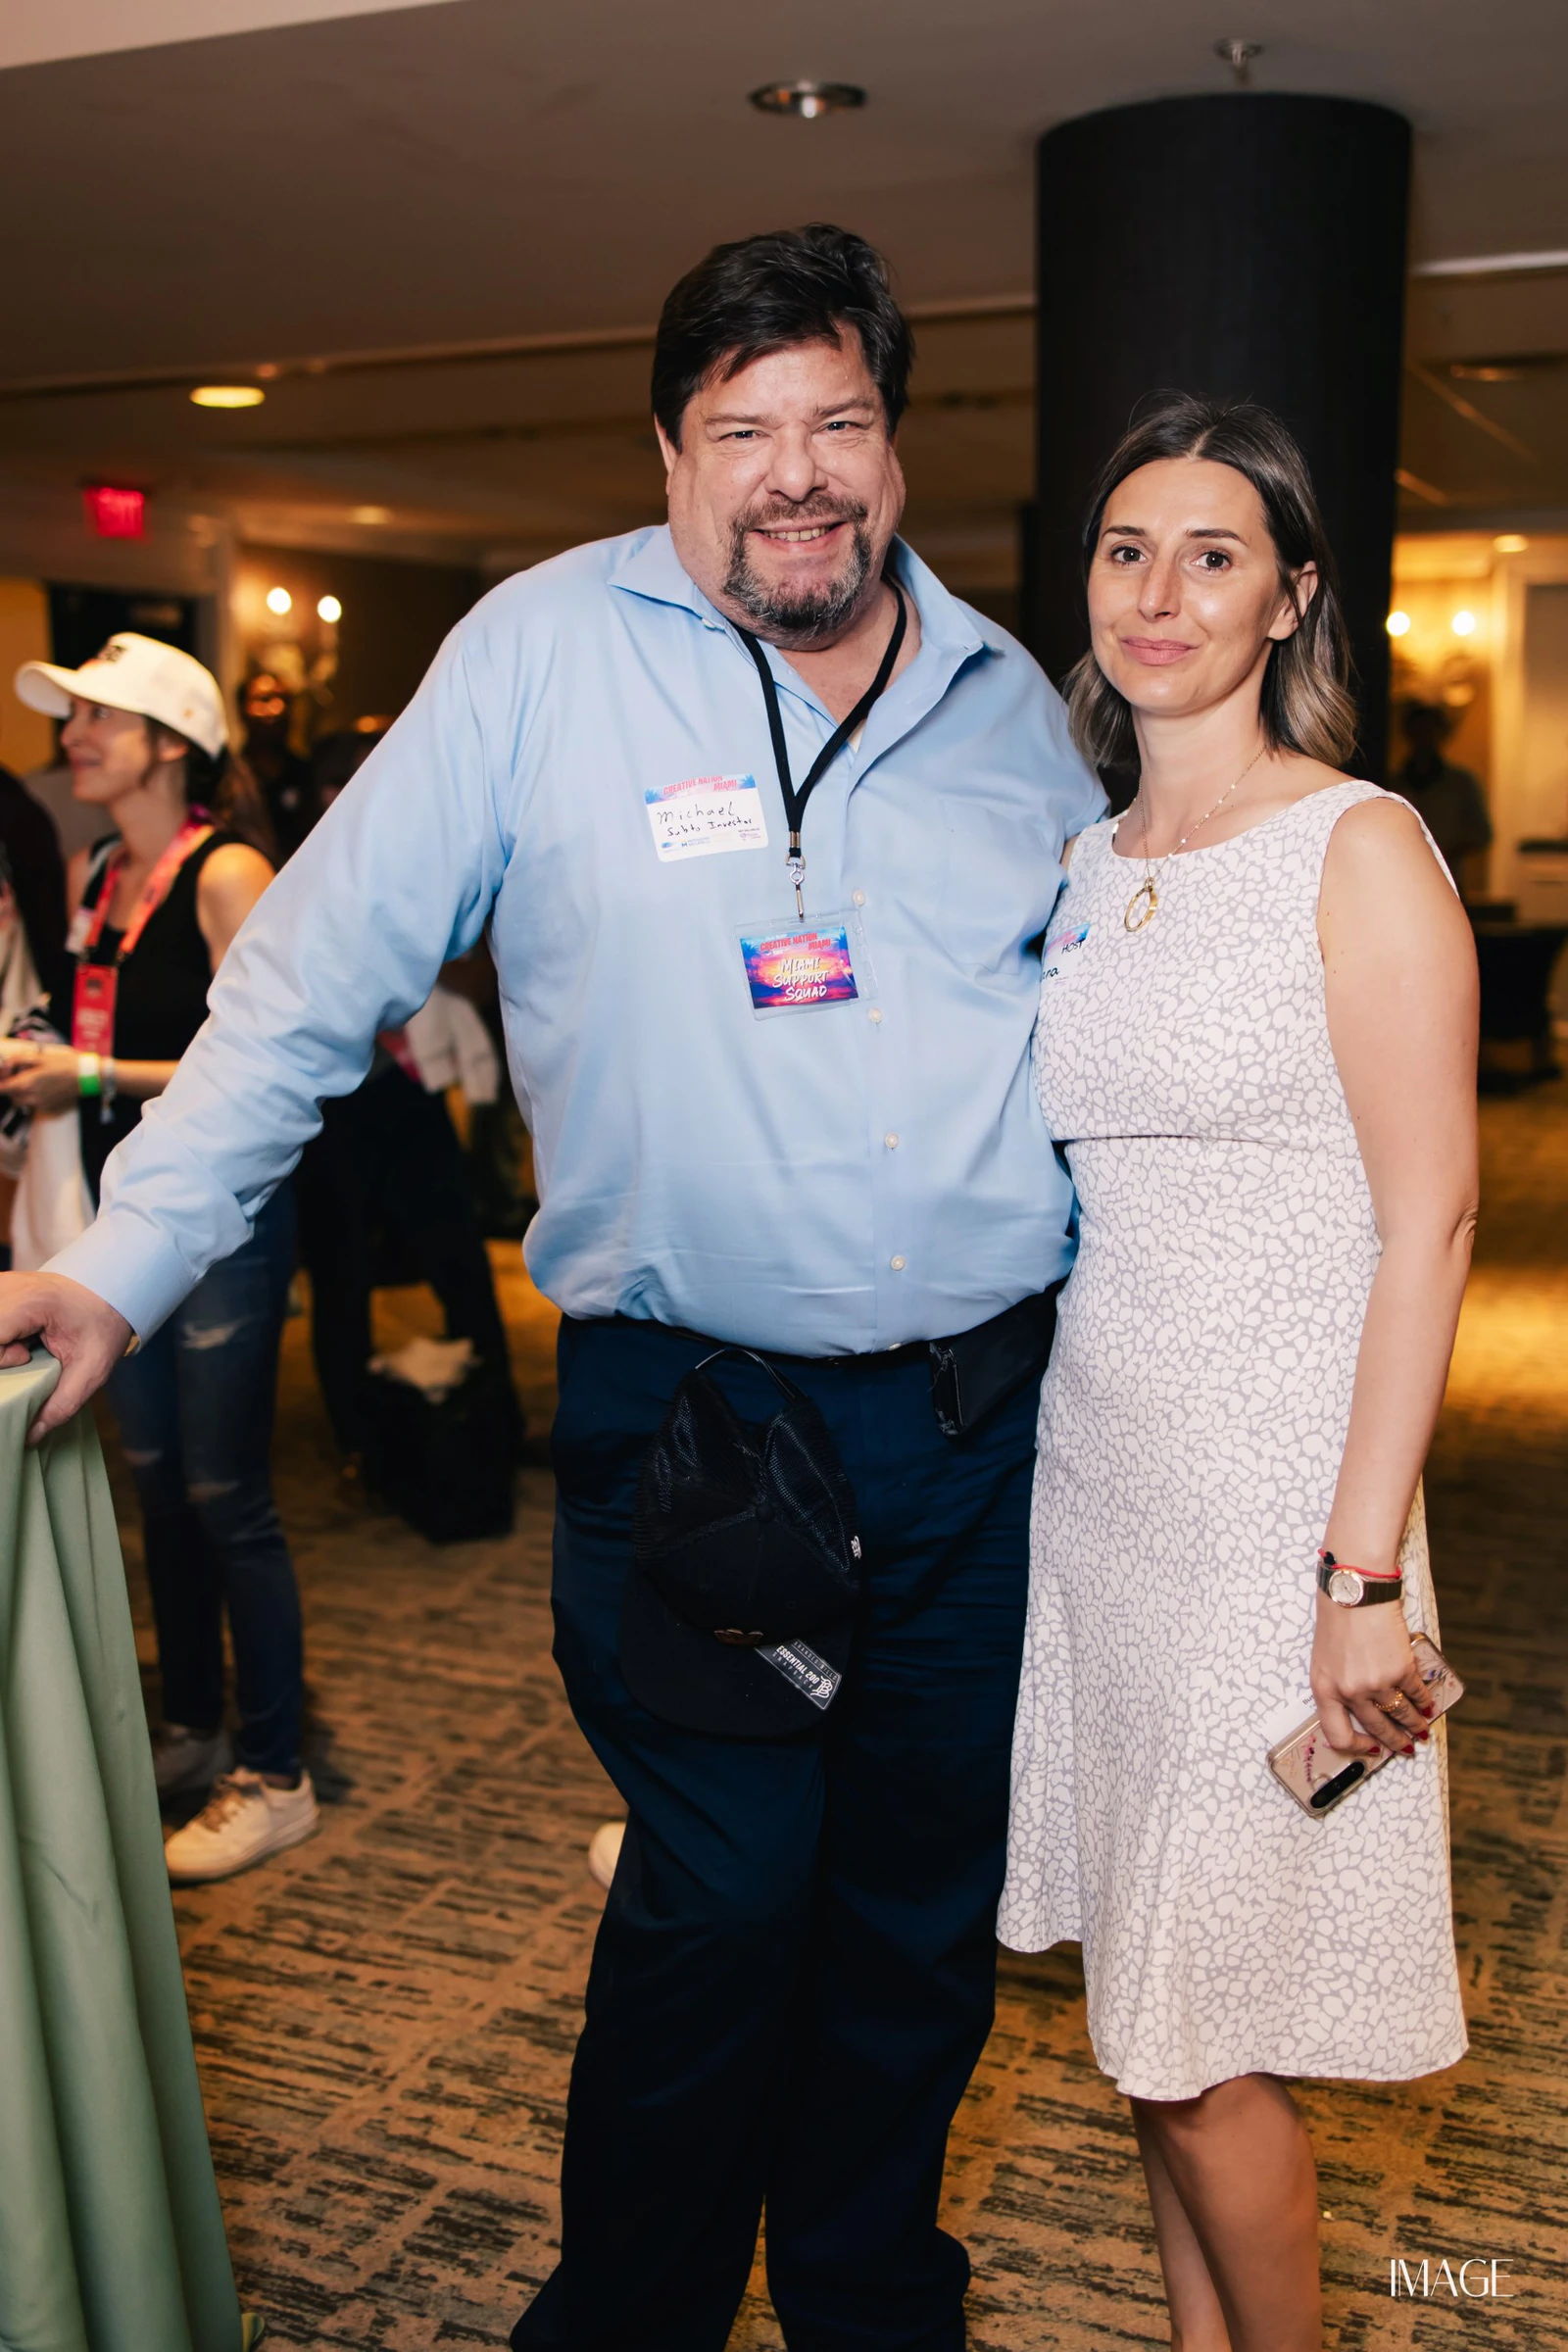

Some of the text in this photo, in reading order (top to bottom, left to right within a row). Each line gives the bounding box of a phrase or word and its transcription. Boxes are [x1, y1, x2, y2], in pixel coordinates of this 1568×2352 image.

[662, 775, 723, 795] CREATIVE NATION
[713, 779, 737, 791] MIAMI
[657, 802, 735, 824] Michael
[760, 937, 792, 952] CREATIVE
[793, 932, 818, 944] NATION
[808, 938, 832, 951] MIAMI
[1061, 941, 1082, 955] HOST
[781, 956, 821, 974] MIAMI
[776, 1645, 820, 1685] ESSENTIAL 200
